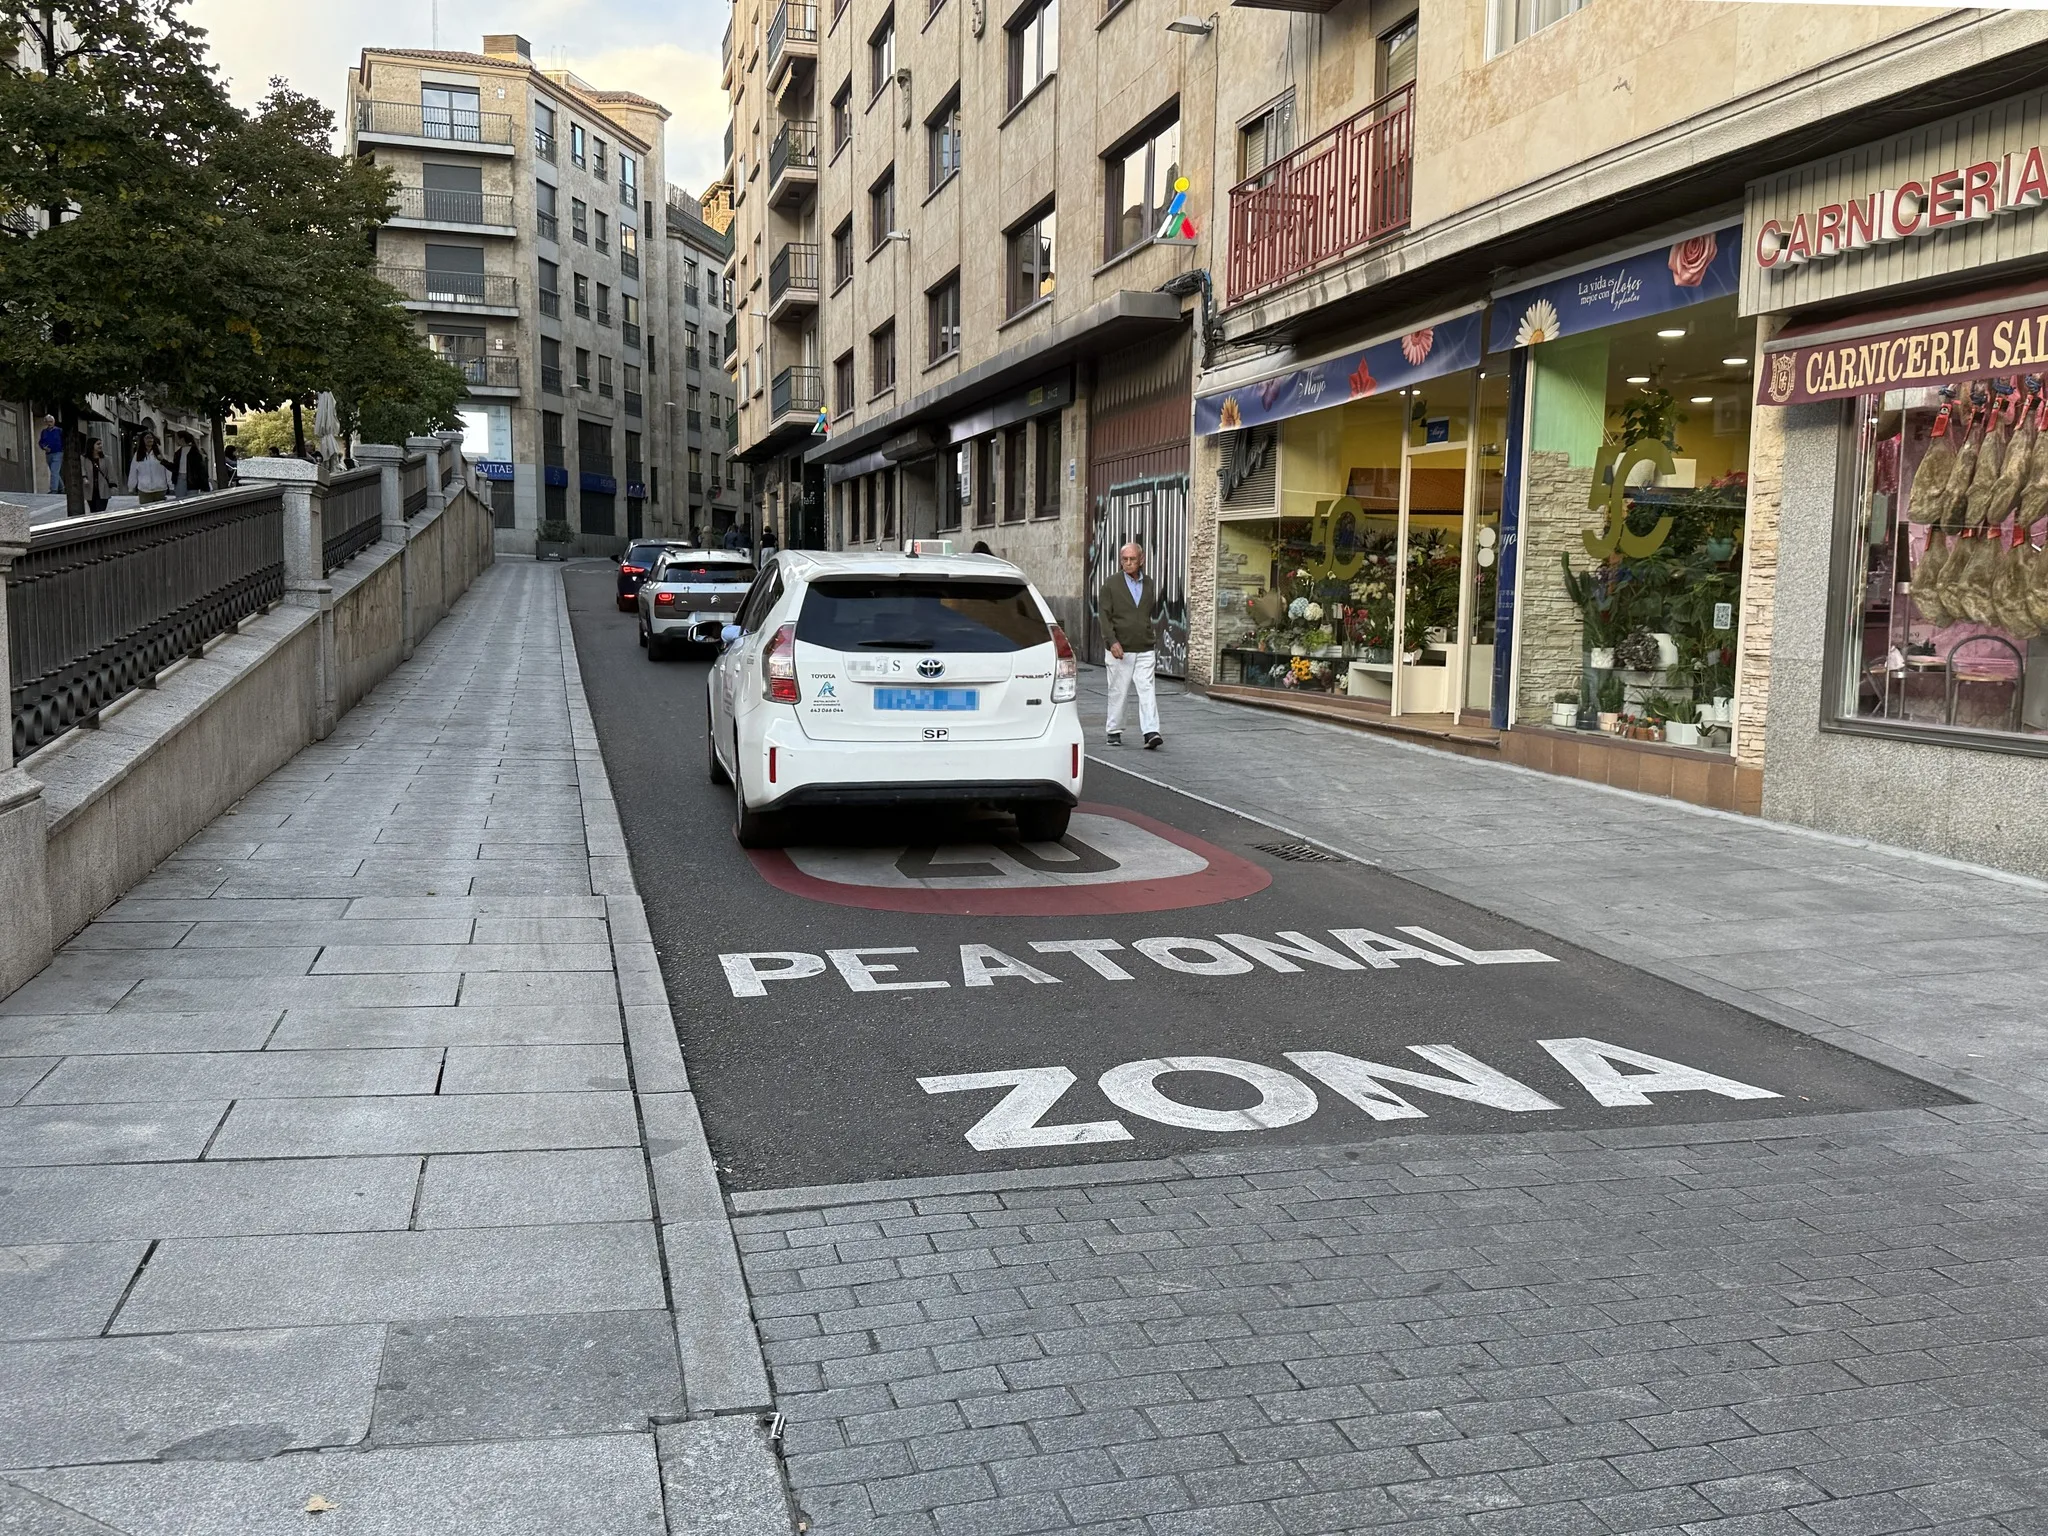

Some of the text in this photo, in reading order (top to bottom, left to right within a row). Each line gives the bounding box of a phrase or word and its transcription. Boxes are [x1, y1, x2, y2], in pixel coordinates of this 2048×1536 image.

[1756, 145, 2048, 269] CARNICERIA
[1578, 282, 1589, 296] La
[1590, 275, 1607, 292] vida
[1580, 289, 1610, 306] mejor con
[1610, 268, 1643, 304] flores
[1805, 325, 1981, 395] CARNICERIA
[892, 659, 902, 672] S
[923, 729, 948, 740] SP
[718, 925, 1560, 998] PEATONAL
[916, 1037, 1783, 1152] ZONA
